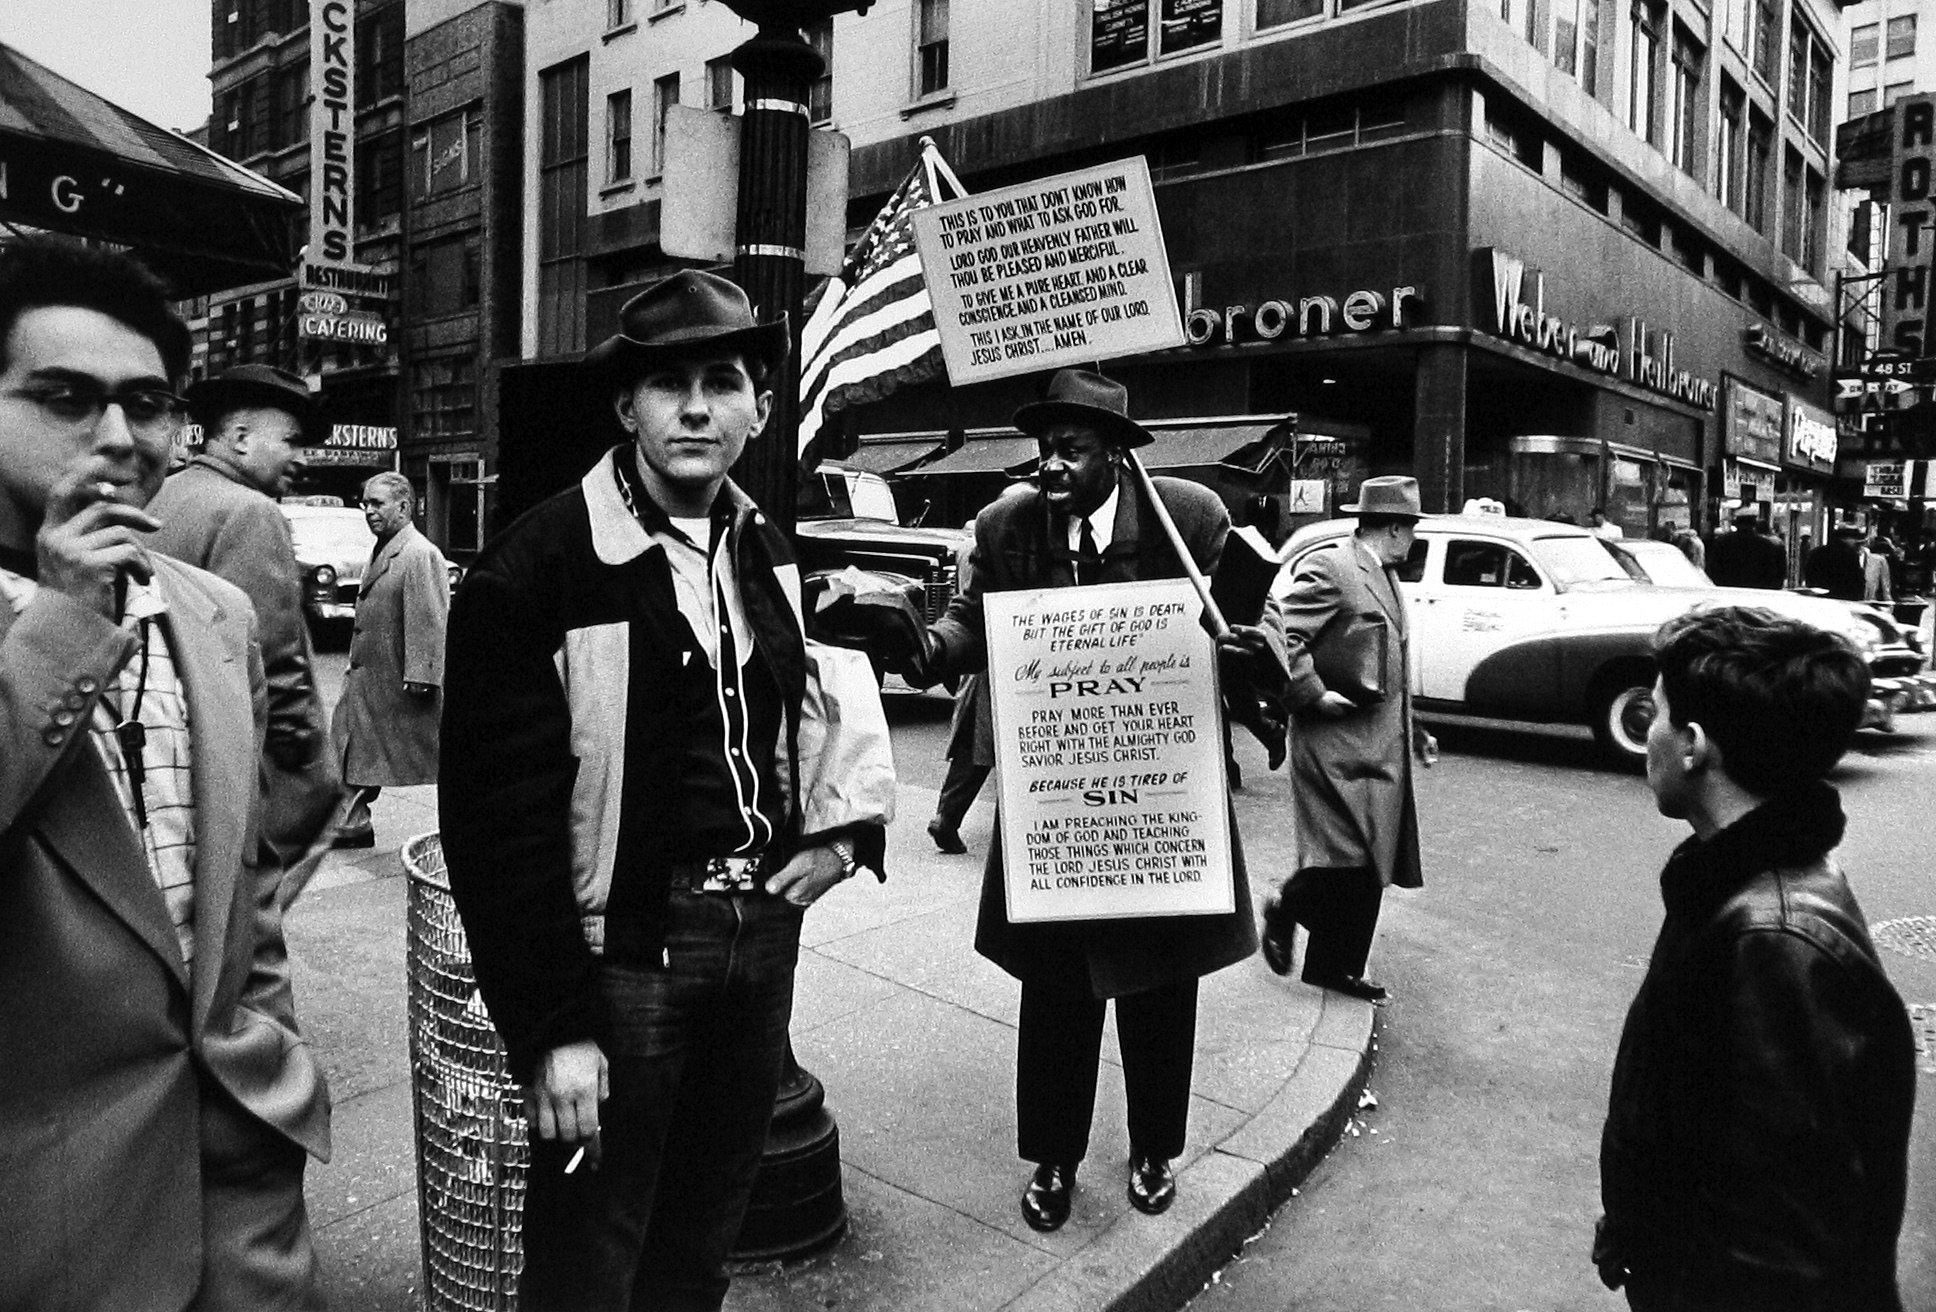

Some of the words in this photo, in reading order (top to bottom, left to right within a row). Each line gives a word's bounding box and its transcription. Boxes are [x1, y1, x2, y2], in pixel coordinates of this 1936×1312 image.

[323, 2, 347, 260] CKSTERNS
[939, 212, 965, 233] THIS
[965, 209, 978, 227] IS
[978, 206, 994, 223] TO
[993, 200, 1016, 222] YOU
[1014, 195, 1039, 215] THAT
[1072, 180, 1103, 202] KNOW
[1104, 175, 1126, 194] HOW
[939, 233, 954, 250] TO
[956, 226, 982, 246] PRAY
[985, 221, 1006, 240] AND
[1006, 214, 1035, 235] WHAT
[1037, 211, 1051, 228] TO
[1052, 206, 1074, 226] ASK
[1074, 200, 1097, 220] GOD
[950, 251, 975, 271] LORD
[1000, 241, 1021, 260] OUR
[1019, 229, 1071, 255] HEAVENLY
[1074, 222, 1112, 244] FATHER
[1112, 218, 1139, 236] WILL
[950, 270, 978, 290] THOU
[980, 266, 995, 283] BE
[996, 256, 1042, 280] PLEASED
[1044, 250, 1067, 270] AND
[960, 294, 973, 309] TO
[975, 289, 998, 306] GIVE
[999, 285, 1015, 302] ME
[1016, 284, 1025, 299] A
[1024, 277, 1052, 296] PURE
[1085, 266, 1107, 285] AND
[1108, 265, 1118, 280] A
[1117, 258, 1149, 278] CLEAR
[1017, 298, 1038, 315] AND
[1040, 296, 1048, 311] A
[1049, 286, 1097, 309] CLEANSED
[1492, 248, 1576, 358] Weber
[306, 317, 387, 342] CATERING
[970, 330, 993, 347] THIS
[994, 329, 1000, 344] I
[1020, 323, 1034, 338] IN
[1033, 318, 1053, 338] THE
[1053, 312, 1083, 334] NAME
[1085, 309, 1099, 326] OF
[1101, 305, 1122, 323] OUR
[971, 346, 1002, 366] JESUS
[1860, 364, 1870, 375] W
[1874, 363, 1894, 375] 48
[1898, 362, 1912, 375] ST
[1013, 614, 1035, 627] THE
[1042, 610, 1085, 625] WAGES
[1089, 609, 1103, 620] OF
[1109, 607, 1127, 620] SIN
[1134, 606, 1145, 618] IS
[1023, 627, 1046, 641] BUT
[1053, 625, 1075, 638] THE
[1079, 622, 1106, 636] GIFT
[1110, 621, 1126, 633] OF
[1130, 619, 1152, 634] GOD
[1156, 618, 1168, 630] IS
[1050, 637, 1106, 652] ETERNAL
[1015, 658, 1042, 684] My
[1048, 657, 1095, 683] subject
[1099, 659, 1114, 675] to
[1115, 651, 1139, 677] all
[1137, 653, 1177, 677] people
[1179, 652, 1192, 674] is
[1049, 676, 1146, 699] PRAY
[1032, 708, 1065, 724] PRAY
[1070, 706, 1106, 722] MORE
[1110, 703, 1144, 719] THAN
[1149, 700, 1180, 716] EVER
[1018, 724, 1059, 740] BEFORE
[1064, 722, 1089, 737] AND
[1092, 720, 1117, 735] GET
[1122, 718, 1155, 733] YOUR
[1156, 714, 1196, 731] HEART
[1019, 739, 1052, 754] RIGHT
[1056, 736, 1086, 752] WITH
[1087, 735, 1110, 750] THE
[1112, 730, 1169, 748] ALMIGHTY
[1173, 729, 1196, 744] GOD
[1022, 752, 1064, 769] SAVIOR
[1067, 750, 1109, 766] JESUS
[1113, 746, 1160, 764] CHRIST.
[1028, 777, 1087, 793] BECAUSE
[1090, 776, 1110, 790] HE
[1112, 775, 1127, 788] IS
[1130, 772, 1168, 787] TIRED
[1173, 770, 1188, 784] OF
[1083, 788, 1138, 808] SIN
[1034, 820, 1039, 832] I
[1041, 819, 1060, 832] AM
[1064, 814, 1139, 830] PREACHING
[1141, 812, 1165, 826] THE
[1026, 832, 1052, 846] DOM
[1055, 831, 1071, 845] OF
[1073, 829, 1099, 844] GOD
[1102, 828, 1129, 842] AND
[1132, 824, 1190, 840] TEACHING
[1028, 846, 1062, 861] THOSE
[1065, 843, 1109, 859] THINGS
[1112, 841, 1150, 856] WHICH
[1154, 839, 1205, 854] CONCERN
[1029, 862, 1050, 876] THE
[1054, 860, 1084, 876] LORD
[1087, 858, 1131, 874] JESUS
[1135, 855, 1177, 871] CHRIST
[1181, 854, 1207, 868] WITH
[1031, 878, 1052, 892] ALL
[1056, 873, 1127, 889] CONFIDENCE
[1130, 872, 1144, 885] IN
[1148, 871, 1170, 885] THE
